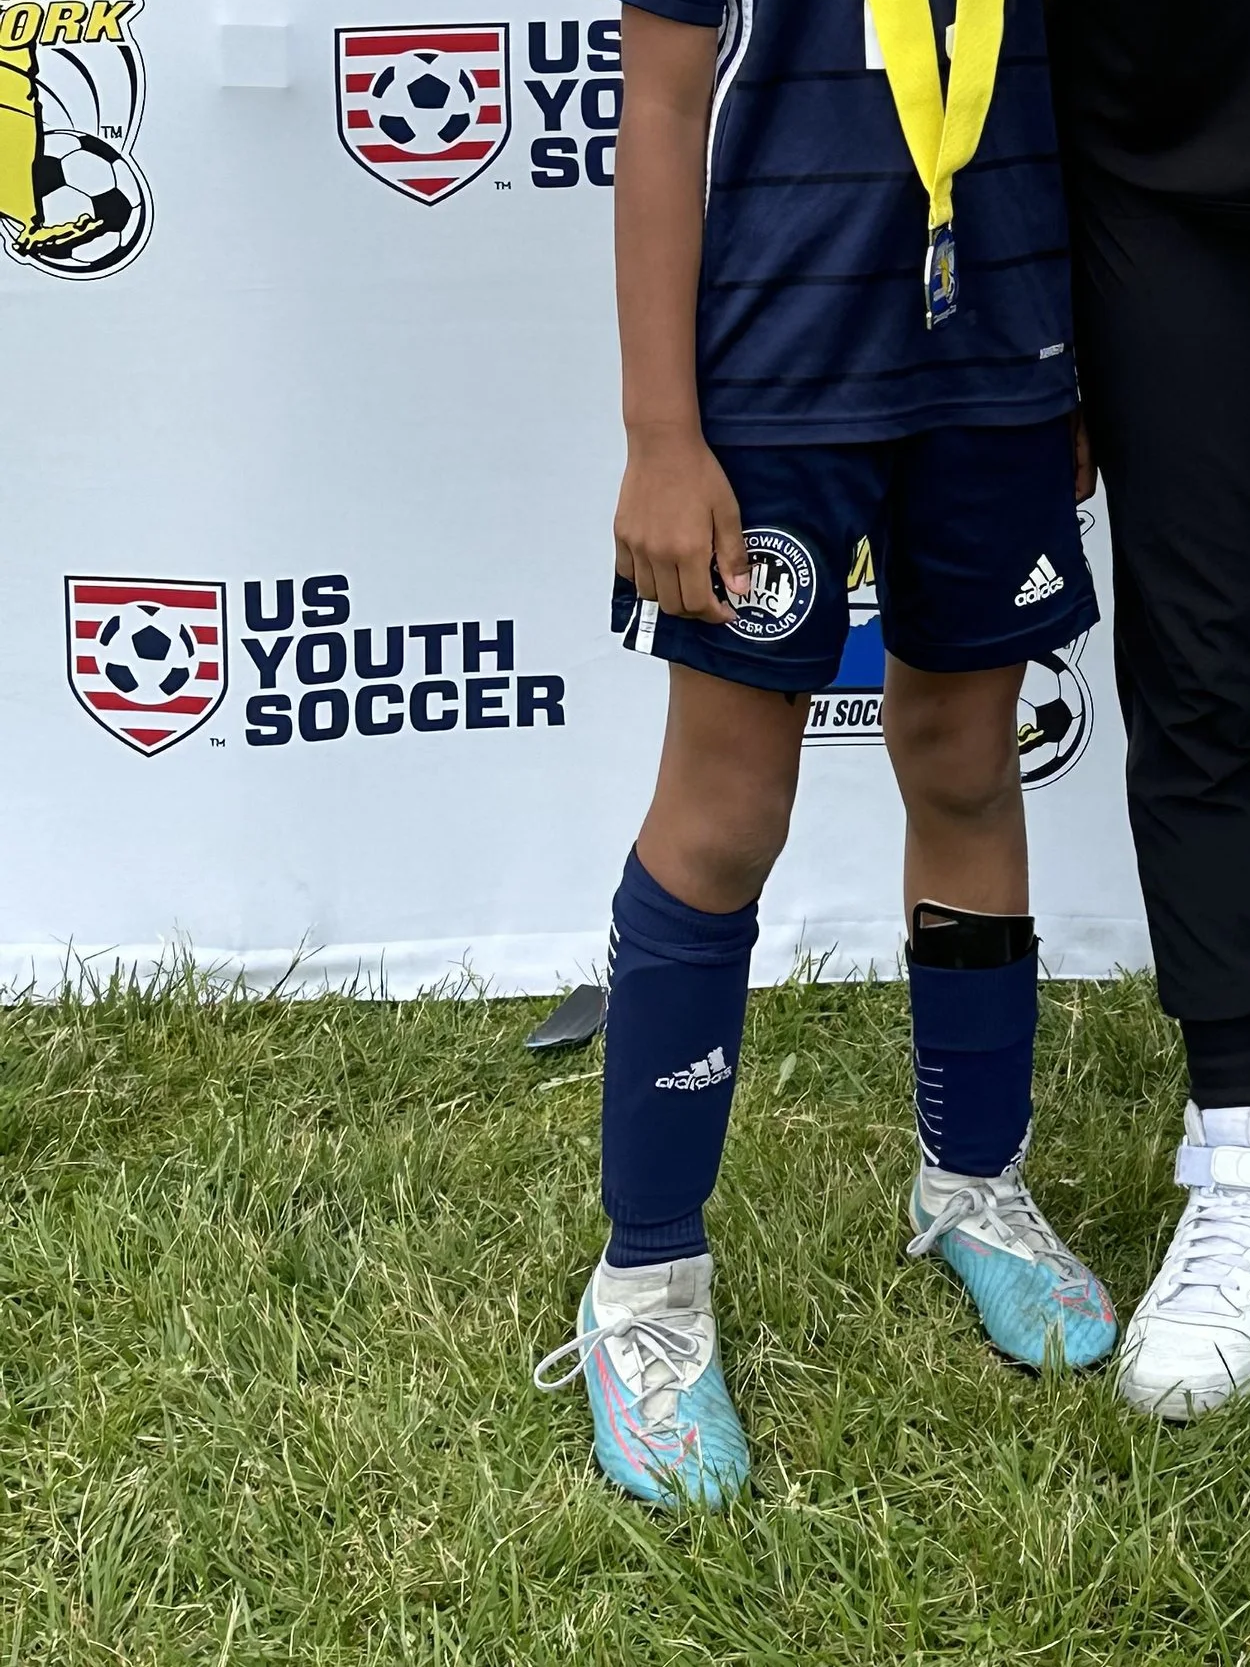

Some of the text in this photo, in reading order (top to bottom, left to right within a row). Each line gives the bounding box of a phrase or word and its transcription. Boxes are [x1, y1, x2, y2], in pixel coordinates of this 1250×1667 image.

[528, 18, 623, 74] US
[784, 542, 811, 587] UNITED
[244, 574, 351, 632] US
[738, 590, 779, 612] NYC
[1014, 576, 1065, 607] adidas
[734, 613, 797, 635] CER CLUB
[241, 619, 514, 689] YOUTH
[245, 675, 565, 746] SOCCER
[832, 699, 884, 727] SOC
[655, 1066, 732, 1091] adidas
